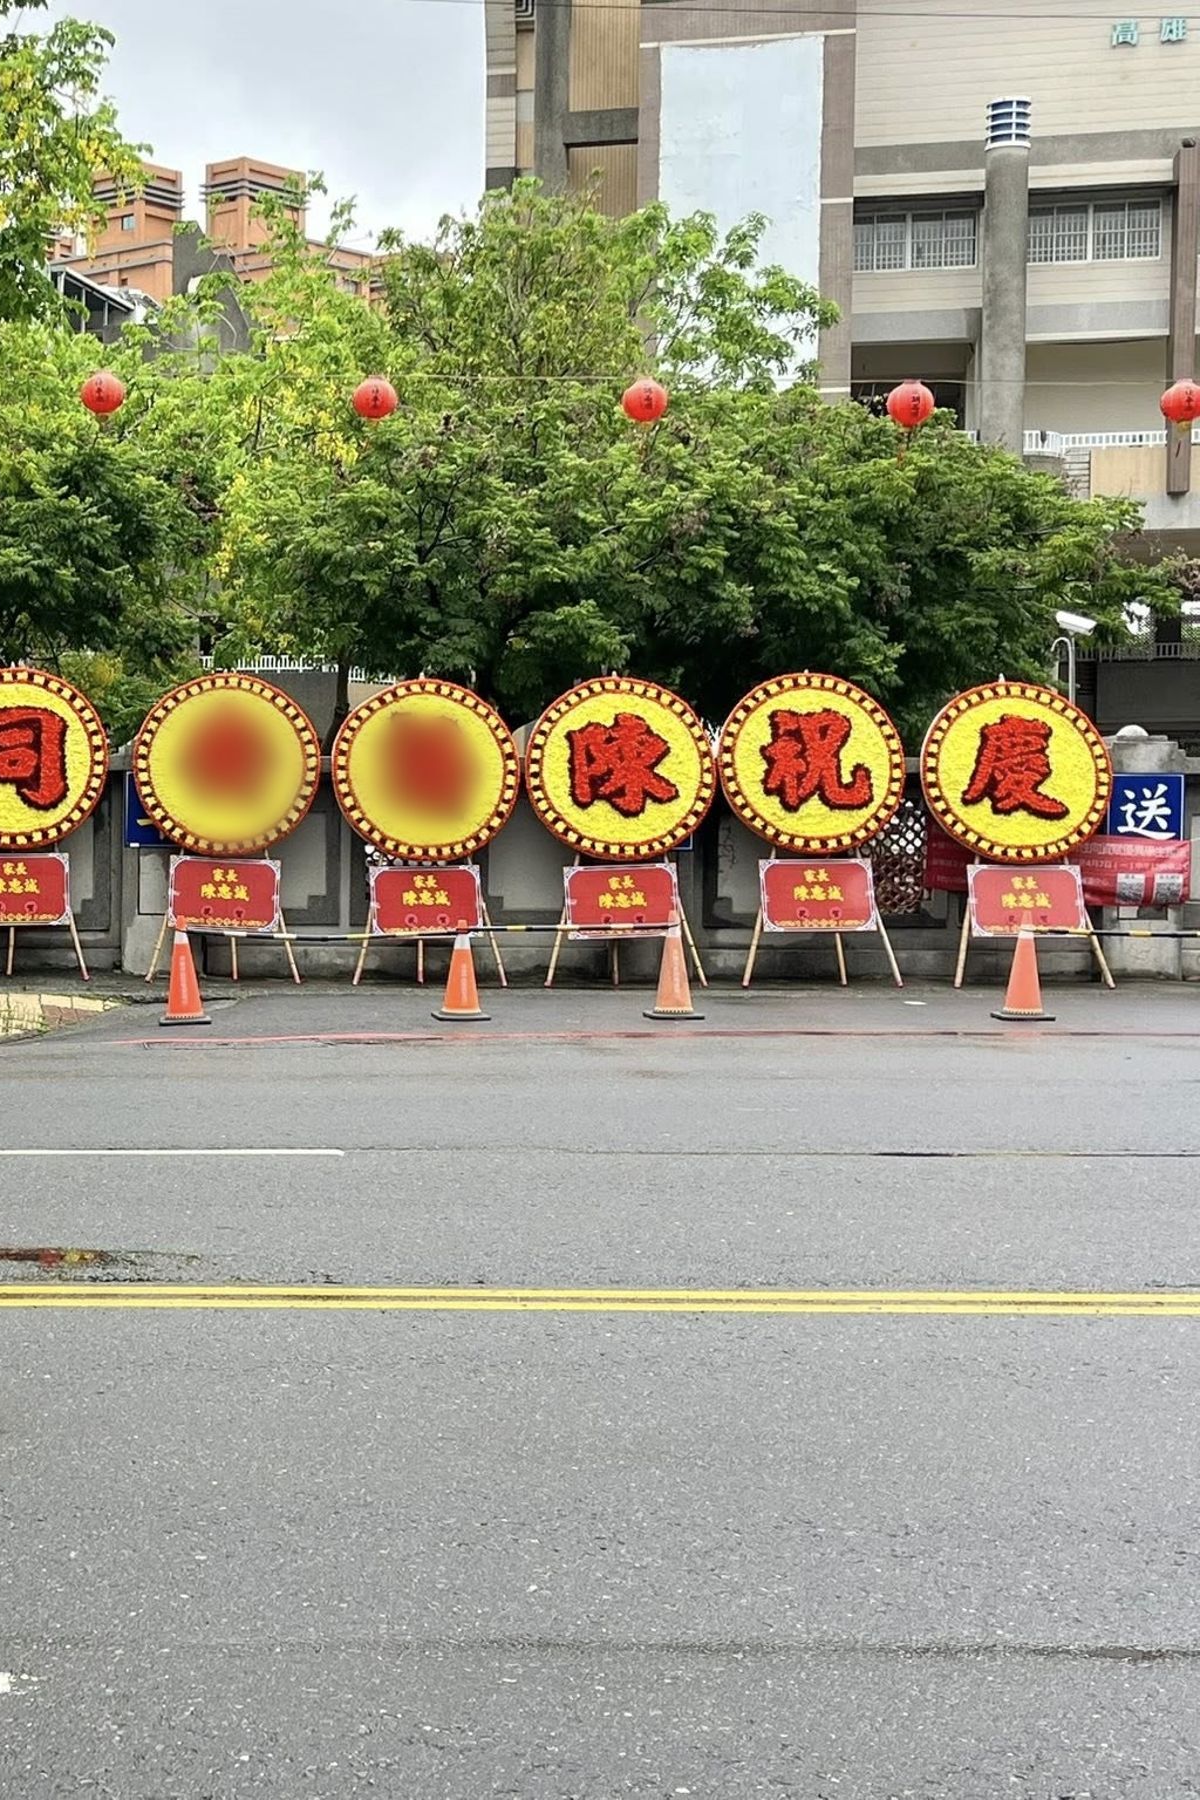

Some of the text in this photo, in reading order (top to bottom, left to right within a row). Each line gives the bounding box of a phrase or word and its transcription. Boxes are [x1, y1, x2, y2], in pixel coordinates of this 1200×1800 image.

[565, 712, 679, 817] 陳
[761, 708, 874, 812] 祝
[961, 714, 1070, 819] 慶
[1117, 783, 1176, 840] 送
[2, 862, 28, 876] 家長
[212, 868, 238, 882] 家長
[803, 868, 830, 883] 家長
[413, 874, 438, 889] 家長
[608, 875, 635, 890] 家長
[1010, 875, 1039, 891] 家長
